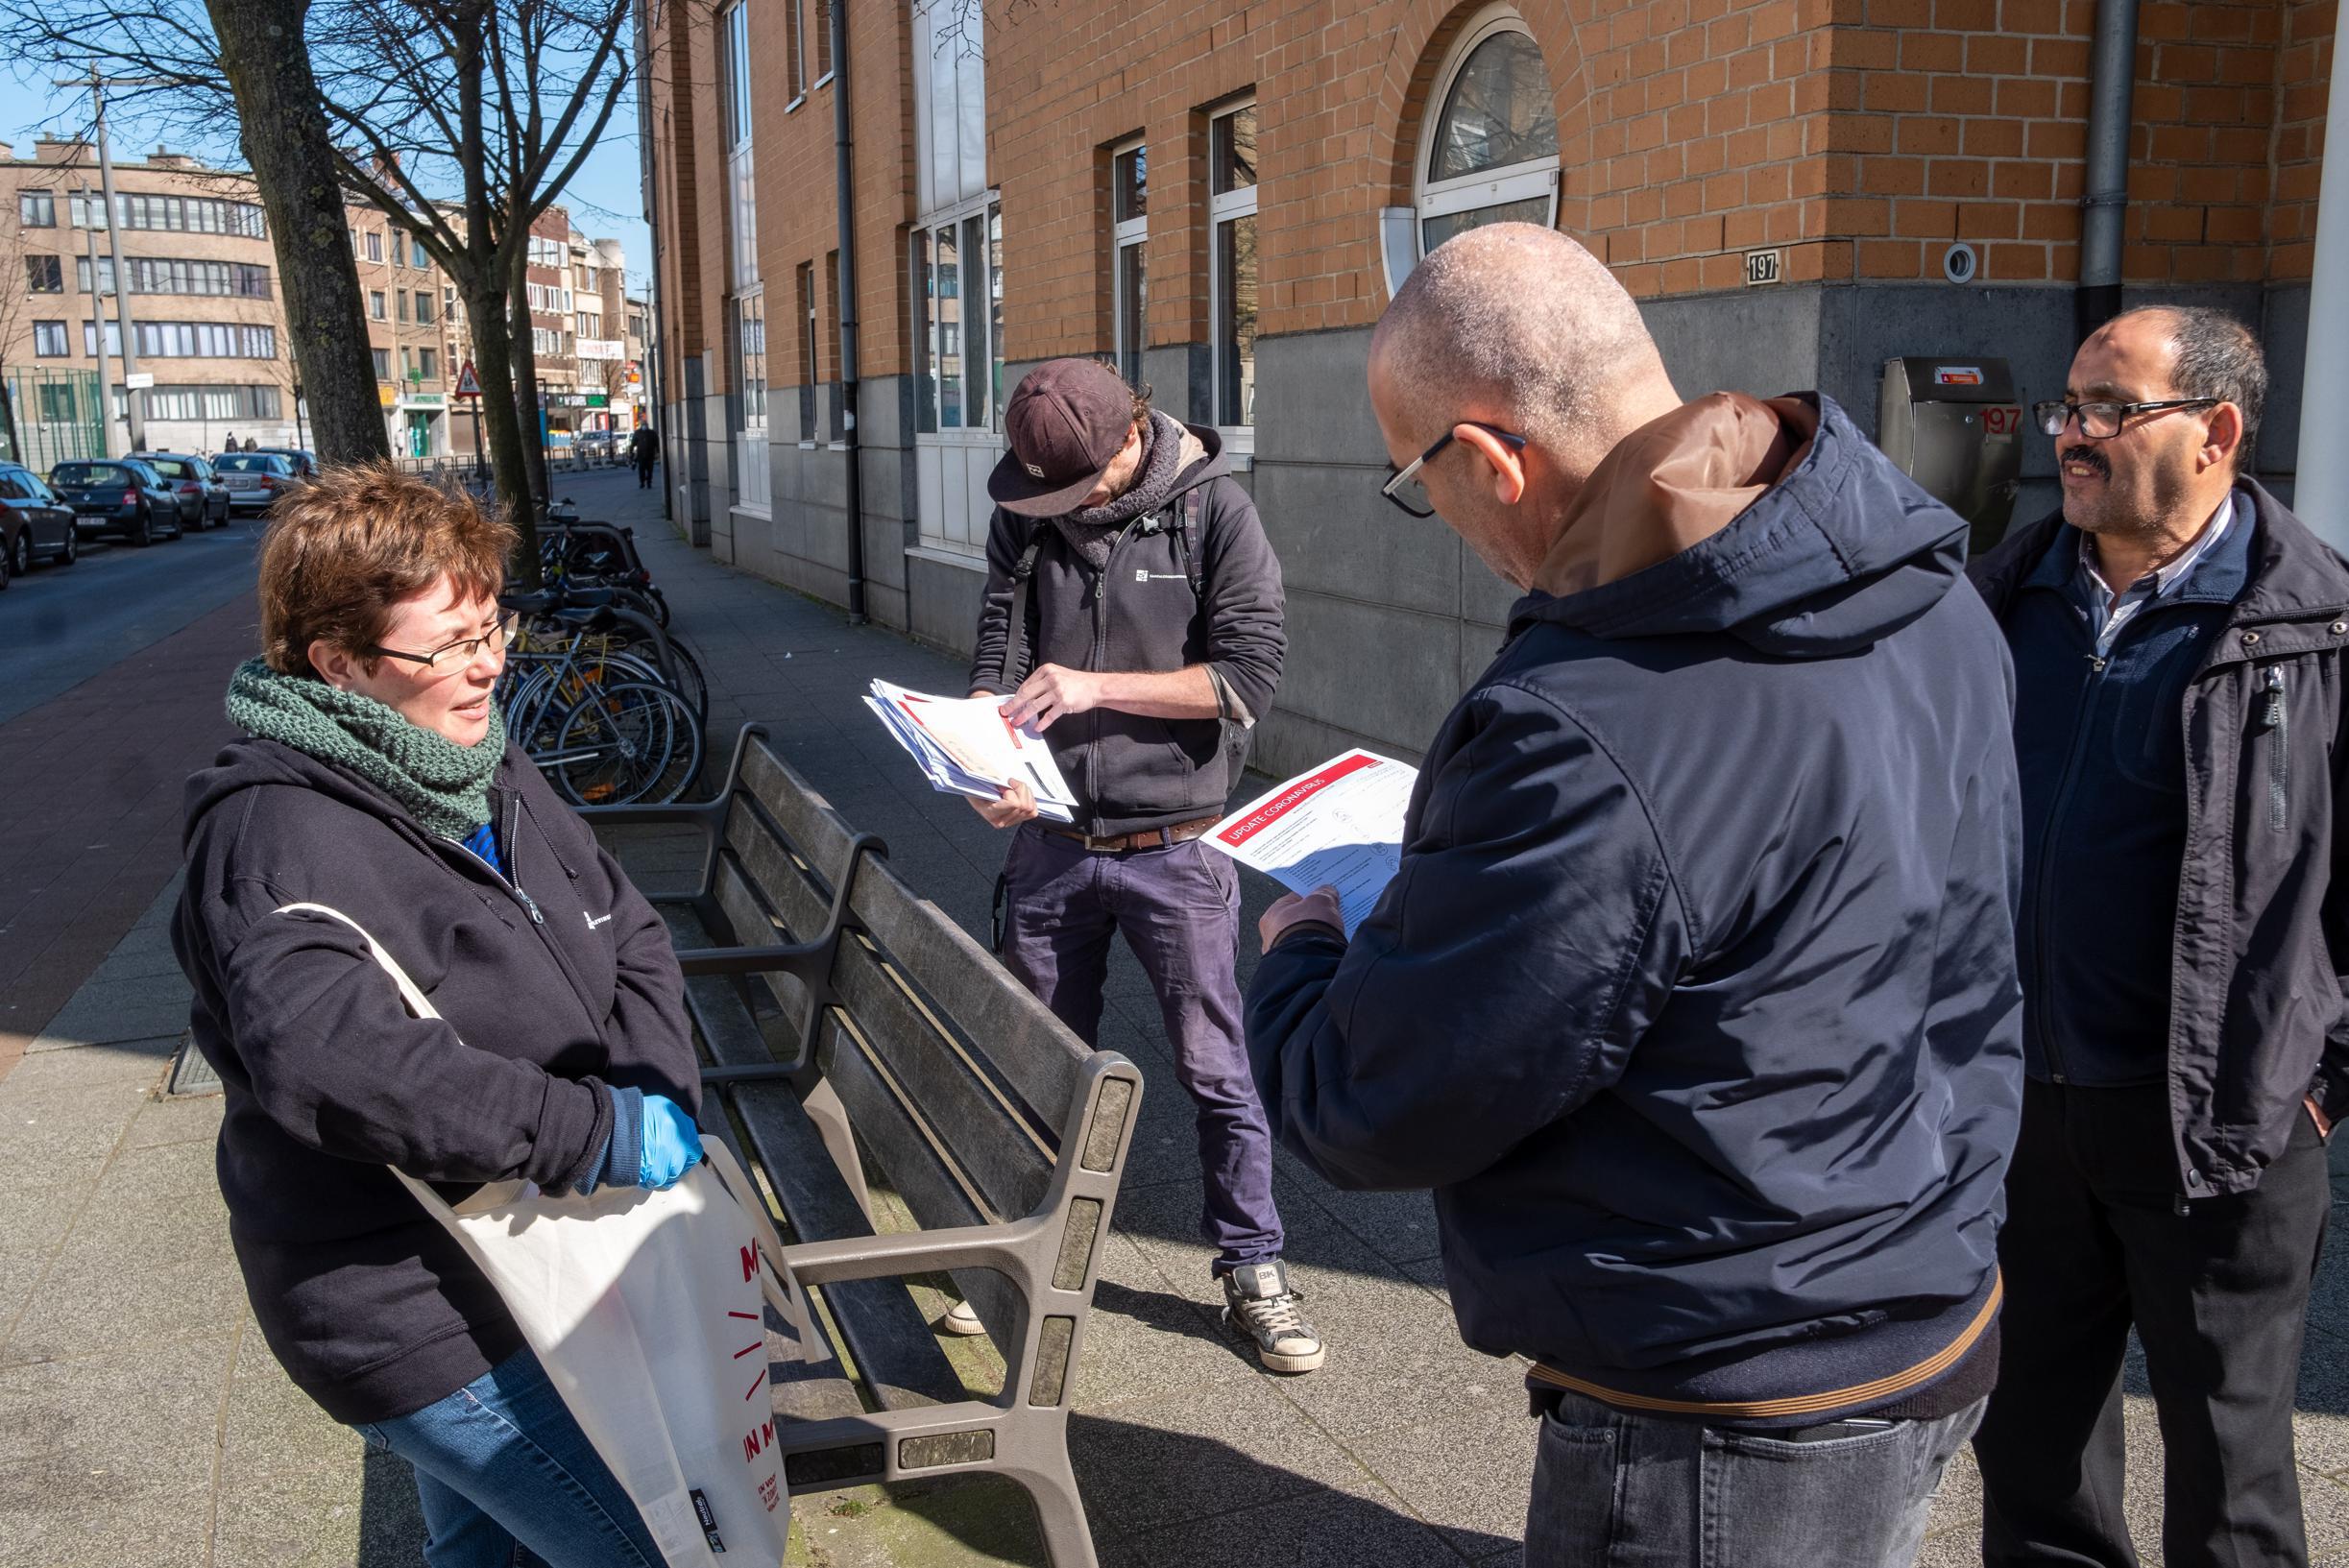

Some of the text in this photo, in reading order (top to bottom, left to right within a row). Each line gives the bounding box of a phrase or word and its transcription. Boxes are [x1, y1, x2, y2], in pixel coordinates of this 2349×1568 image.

[1751, 253, 1775, 279] 197
[1979, 407, 2022, 434] 197
[1228, 814, 1267, 840] UPDATE
[1264, 778, 1325, 818] CORONAVIRUS
[1258, 1269, 1275, 1280] BK
[742, 1428, 761, 1463] IN
